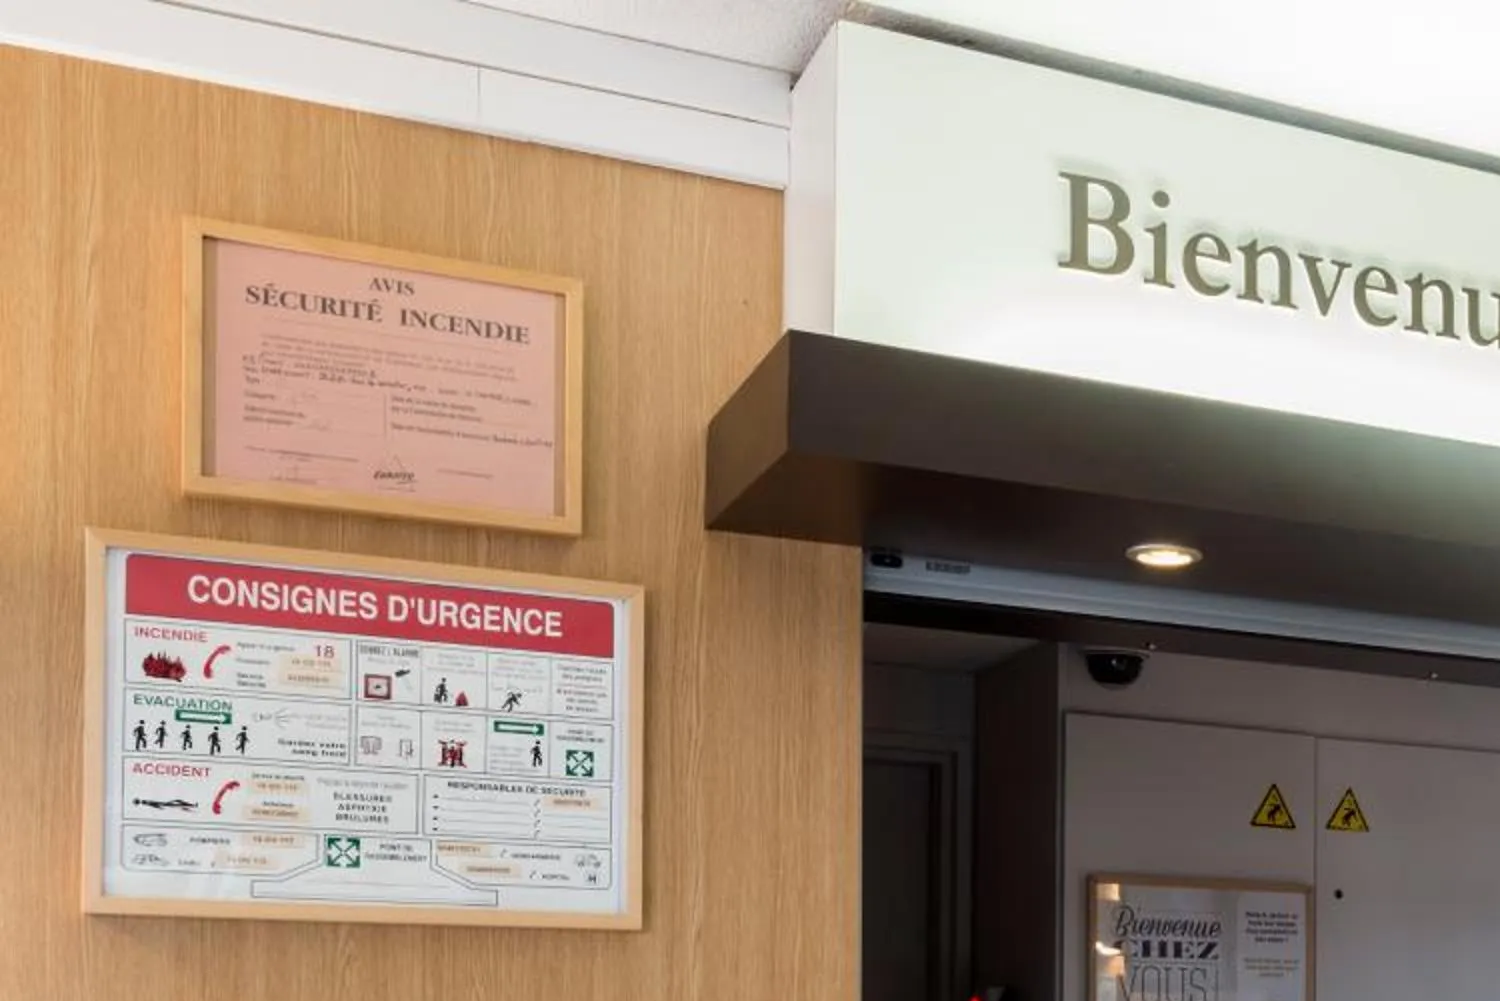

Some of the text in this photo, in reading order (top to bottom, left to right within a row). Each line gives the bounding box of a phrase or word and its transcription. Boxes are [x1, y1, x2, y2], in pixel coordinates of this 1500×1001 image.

[369, 276, 415, 296] AVIS
[245, 282, 531, 345] SÉCURITÉ INCENDIE
[187, 574, 563, 638] CONSIGNES D'URGENCE
[133, 625, 208, 643] INCENDIE
[315, 644, 335, 659] 18
[133, 693, 233, 711] EVACUATION
[132, 762, 212, 778] ACCIDENT
[1114, 905, 1221, 938] Bienvenue
